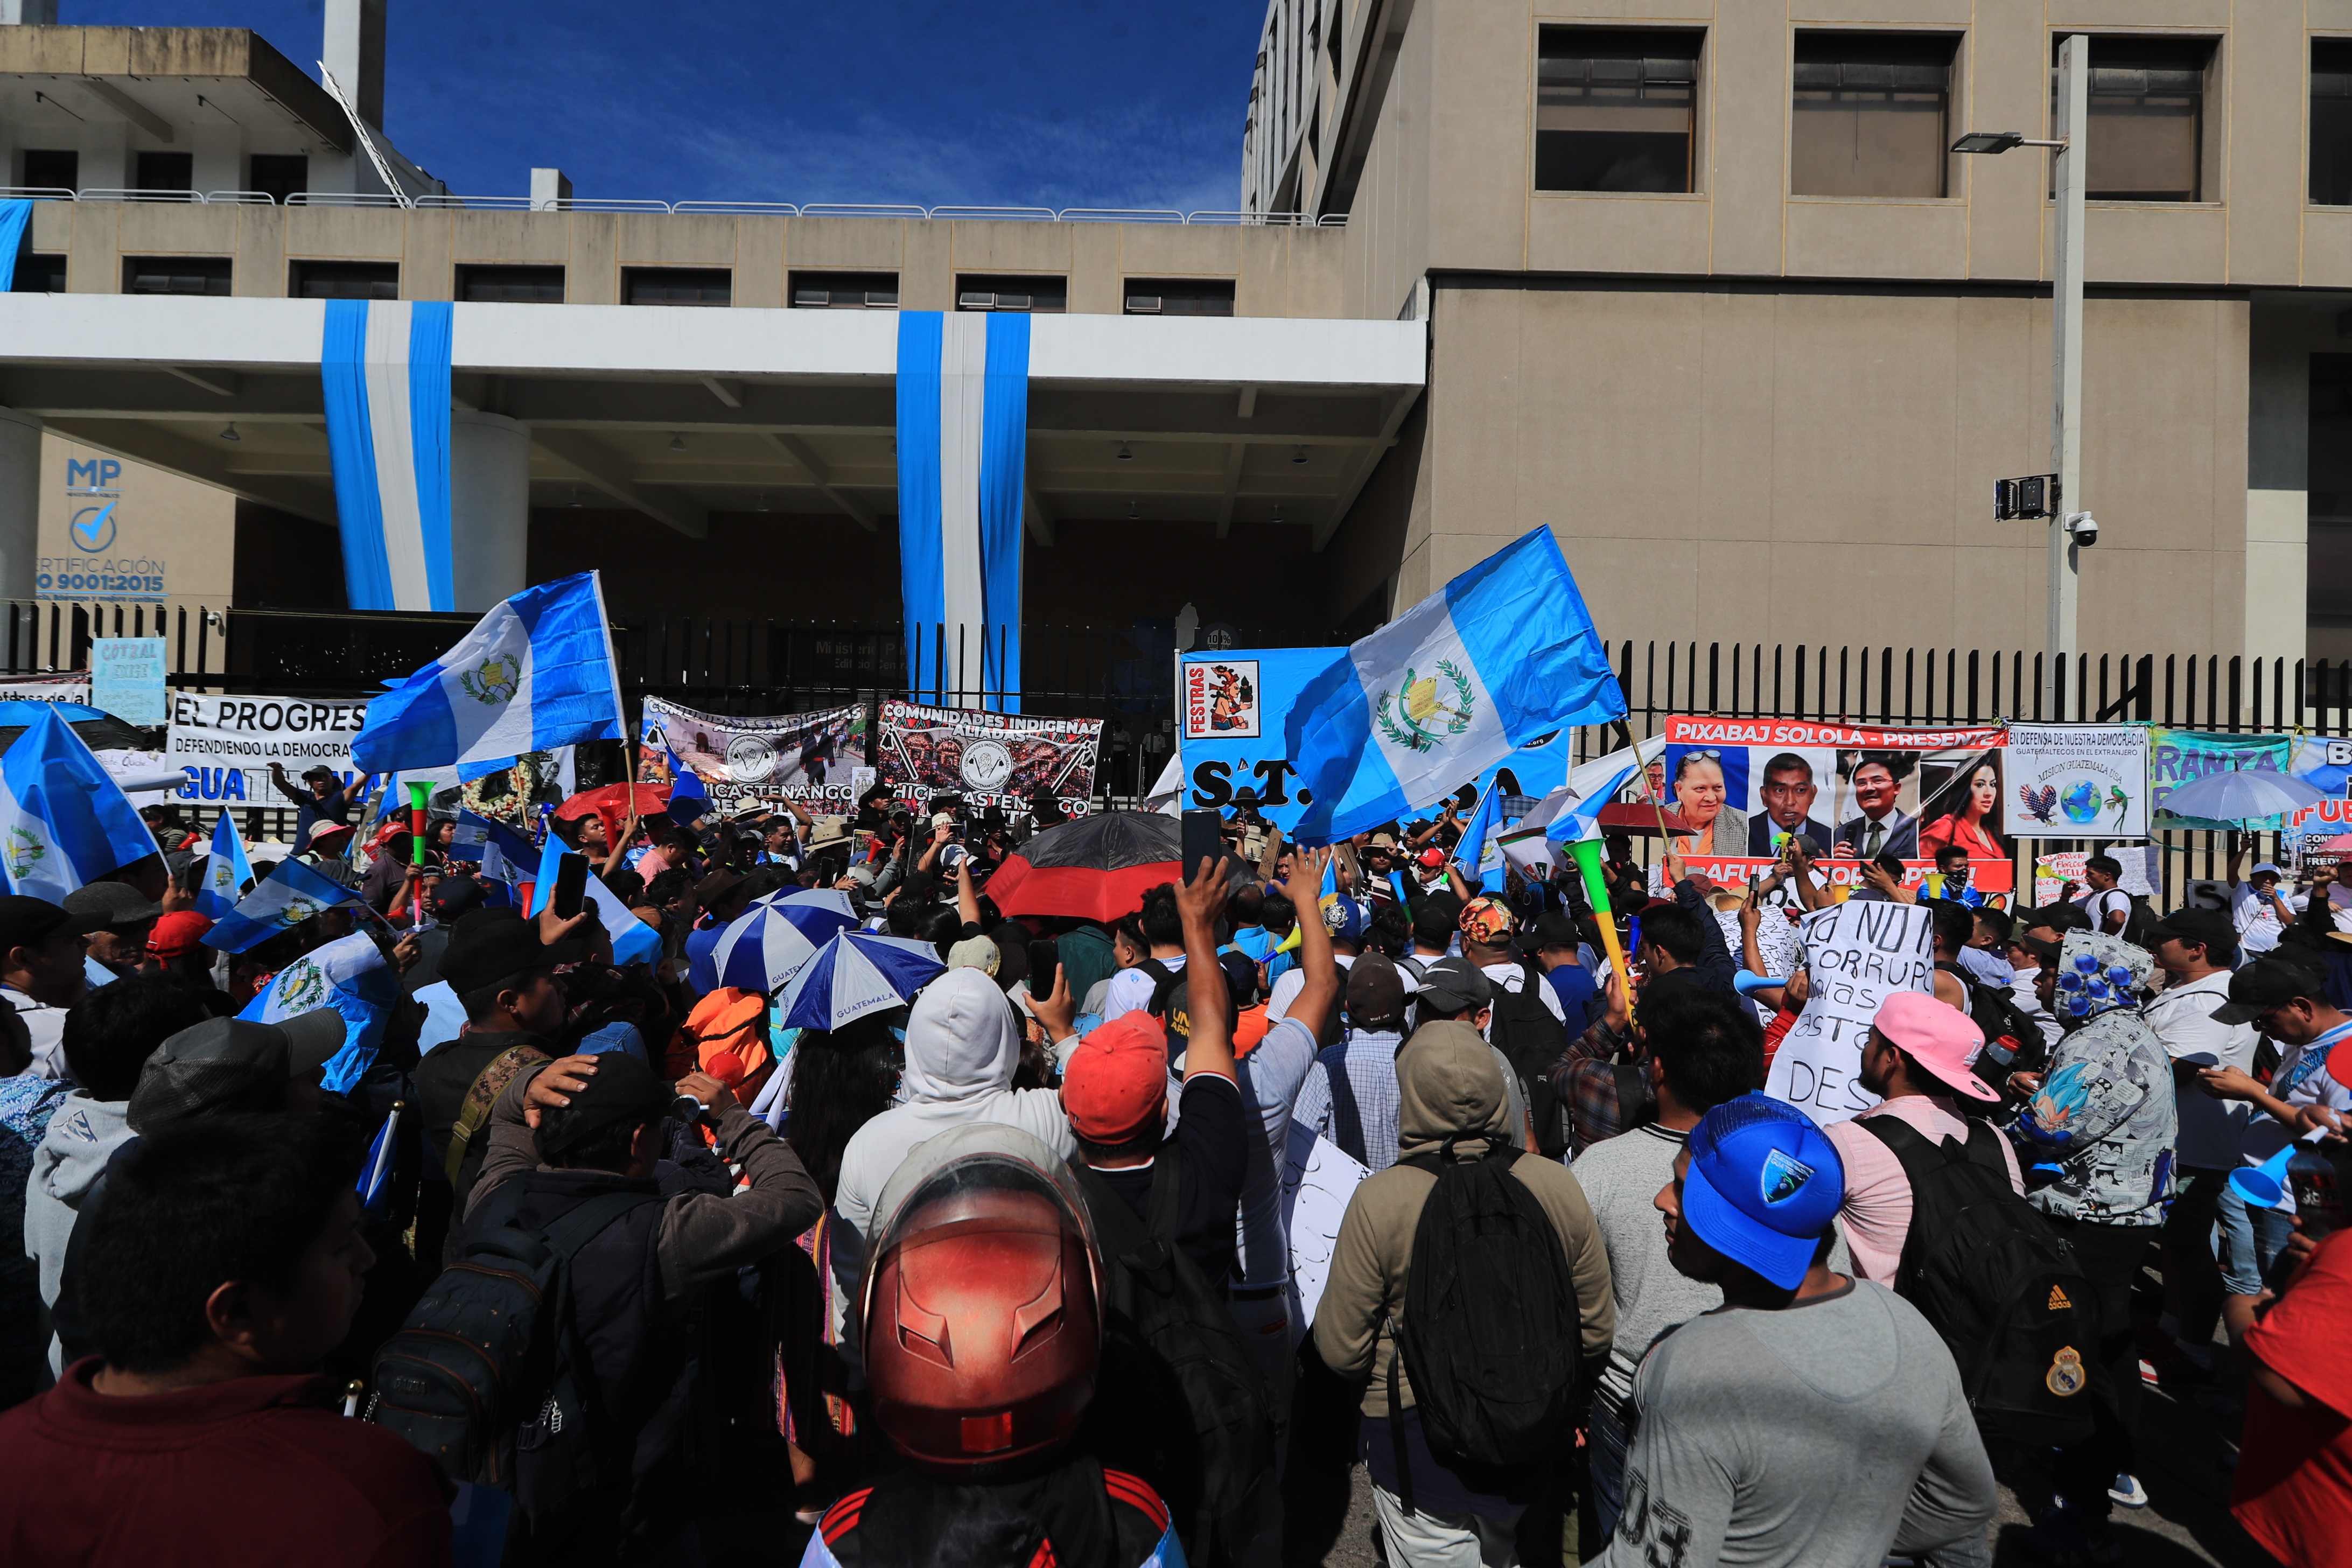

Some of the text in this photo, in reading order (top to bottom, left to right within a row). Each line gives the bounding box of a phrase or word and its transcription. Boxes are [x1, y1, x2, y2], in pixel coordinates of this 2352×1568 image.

[67, 459, 122, 487] MP
[36, 556, 166, 575] RTIFICACIÓN
[57, 574, 164, 592] 9001:2015
[1189, 667, 1206, 733] FESTRAS
[176, 698, 208, 728] EL
[648, 699, 771, 729] COMUNIDADES
[884, 704, 1005, 728] COMUNIDADES
[712, 725, 792, 736] ALIADAS
[952, 724, 1027, 743] ALIADAS
[1675, 723, 1769, 743] PIXABAJ
[1773, 725, 1862, 745] SOLOLÁ
[1882, 730, 1995, 747] PRESENTE
[2010, 732, 2145, 747] EN DEFENSA DE NUESTRA DEMOCRACIA
[176, 737, 351, 758] DEFENDIENDO LA DEMOCRA
[964, 744, 984, 767] COMUNIDADES
[984, 743, 1005, 754] INDÍGENAS
[2038, 759, 2123, 785] MISION GUATEMALA USA
[1856, 901, 1910, 953] NO
[836, 992, 895, 1018] GUATEMALA
[2048, 1300, 2072, 1310] adidas
